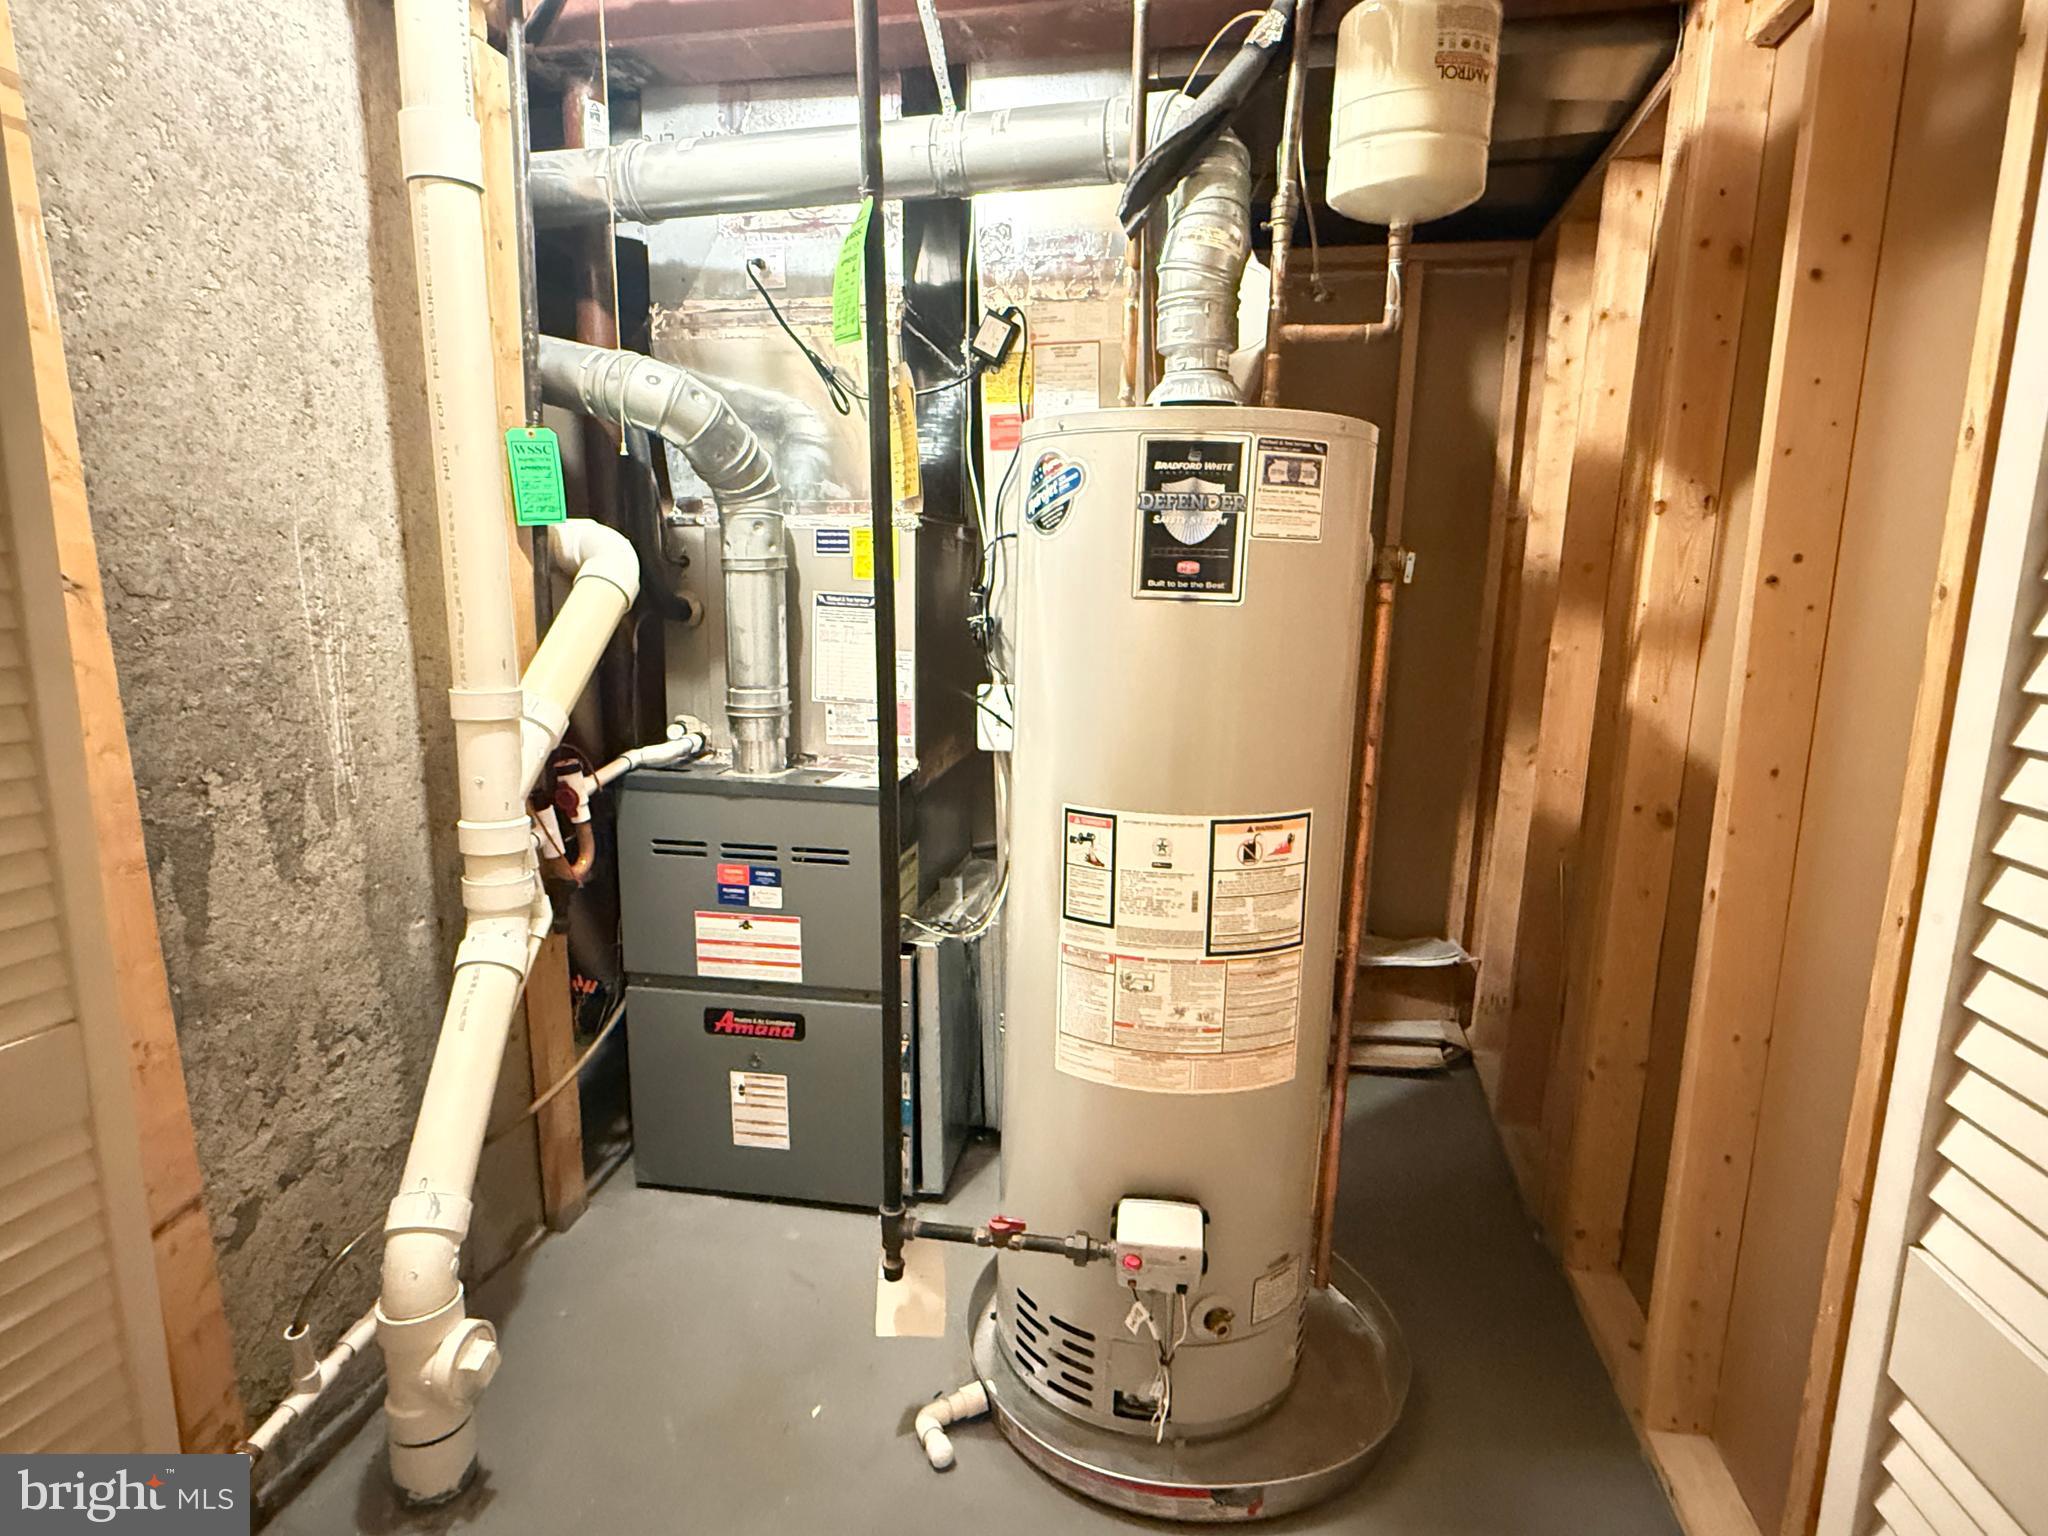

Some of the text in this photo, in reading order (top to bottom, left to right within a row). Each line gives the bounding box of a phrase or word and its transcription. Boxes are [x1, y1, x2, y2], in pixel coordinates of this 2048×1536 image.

[1436, 65, 1489, 84] AMTROL
[425, 274, 440, 379] PRESSURE
[514, 445, 552, 455] WSSC
[440, 445, 451, 481] NOT
[1154, 461, 1235, 472] BRADFORD WHITE
[1138, 491, 1249, 511] DEFENDER
[1147, 579, 1225, 590] Built to be the Best
[714, 1010, 795, 1038] Amana
